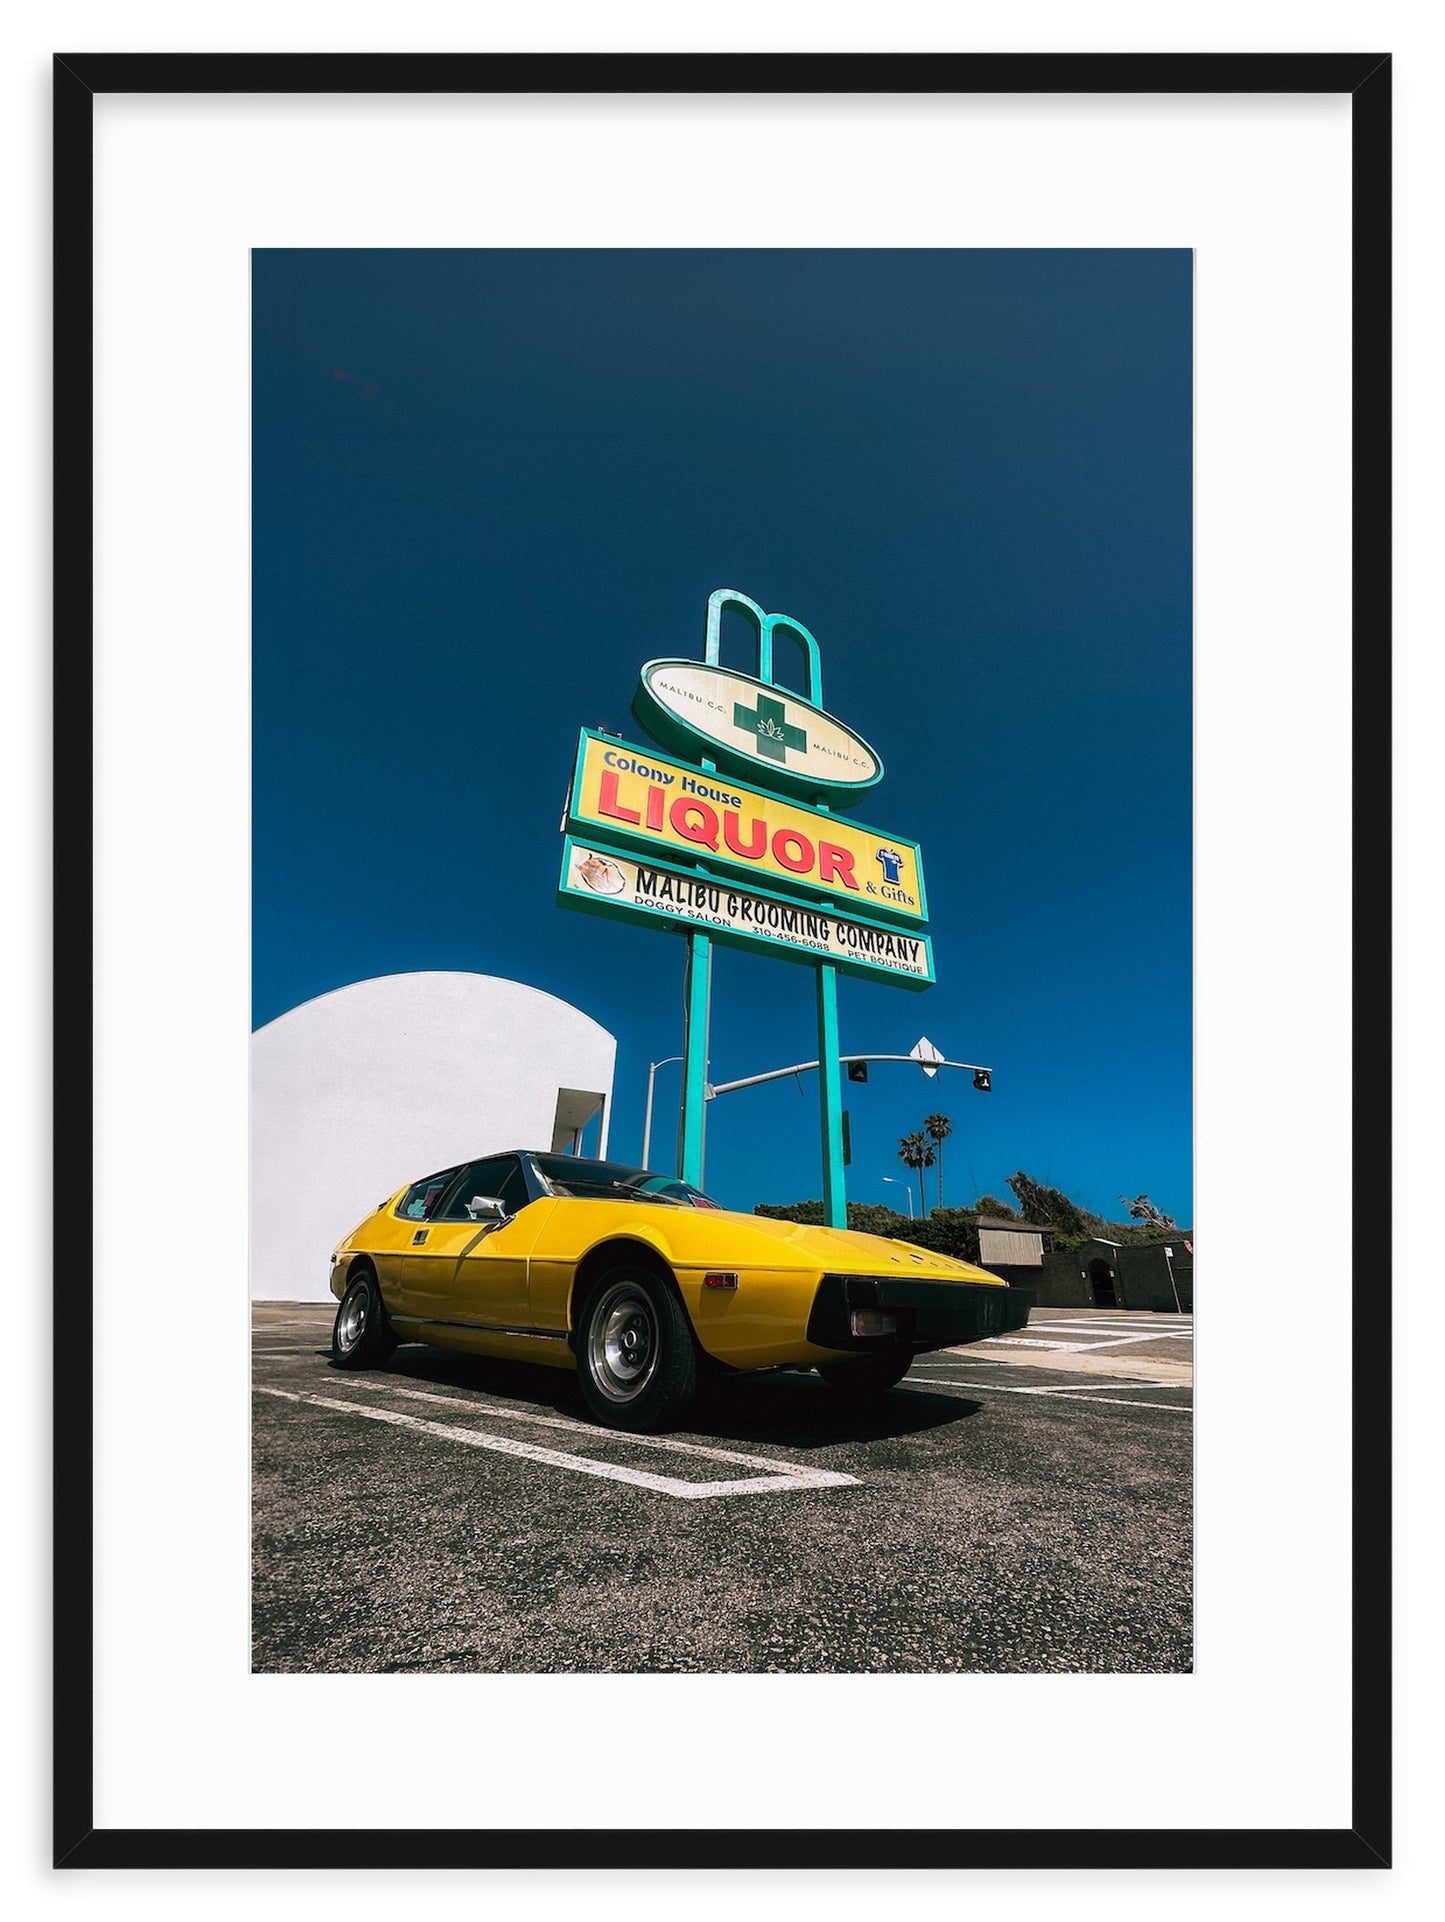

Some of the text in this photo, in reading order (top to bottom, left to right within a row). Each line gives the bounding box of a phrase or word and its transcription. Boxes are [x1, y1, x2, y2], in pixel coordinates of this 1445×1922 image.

[659, 681, 727, 714] MALIBU C.C.
[812, 743, 849, 761] MALIBU
[603, 751, 742, 809] Colony House
[598, 769, 860, 891] LIQUOR
[866, 880, 915, 906] & Gifts
[634, 895, 732, 928] DOGGY SALON
[636, 867, 920, 963] MALIBU GROOMING COMPANY
[752, 925, 830, 952] 310-456-6088
[847, 949, 924, 975] PET BOUTIQUE
